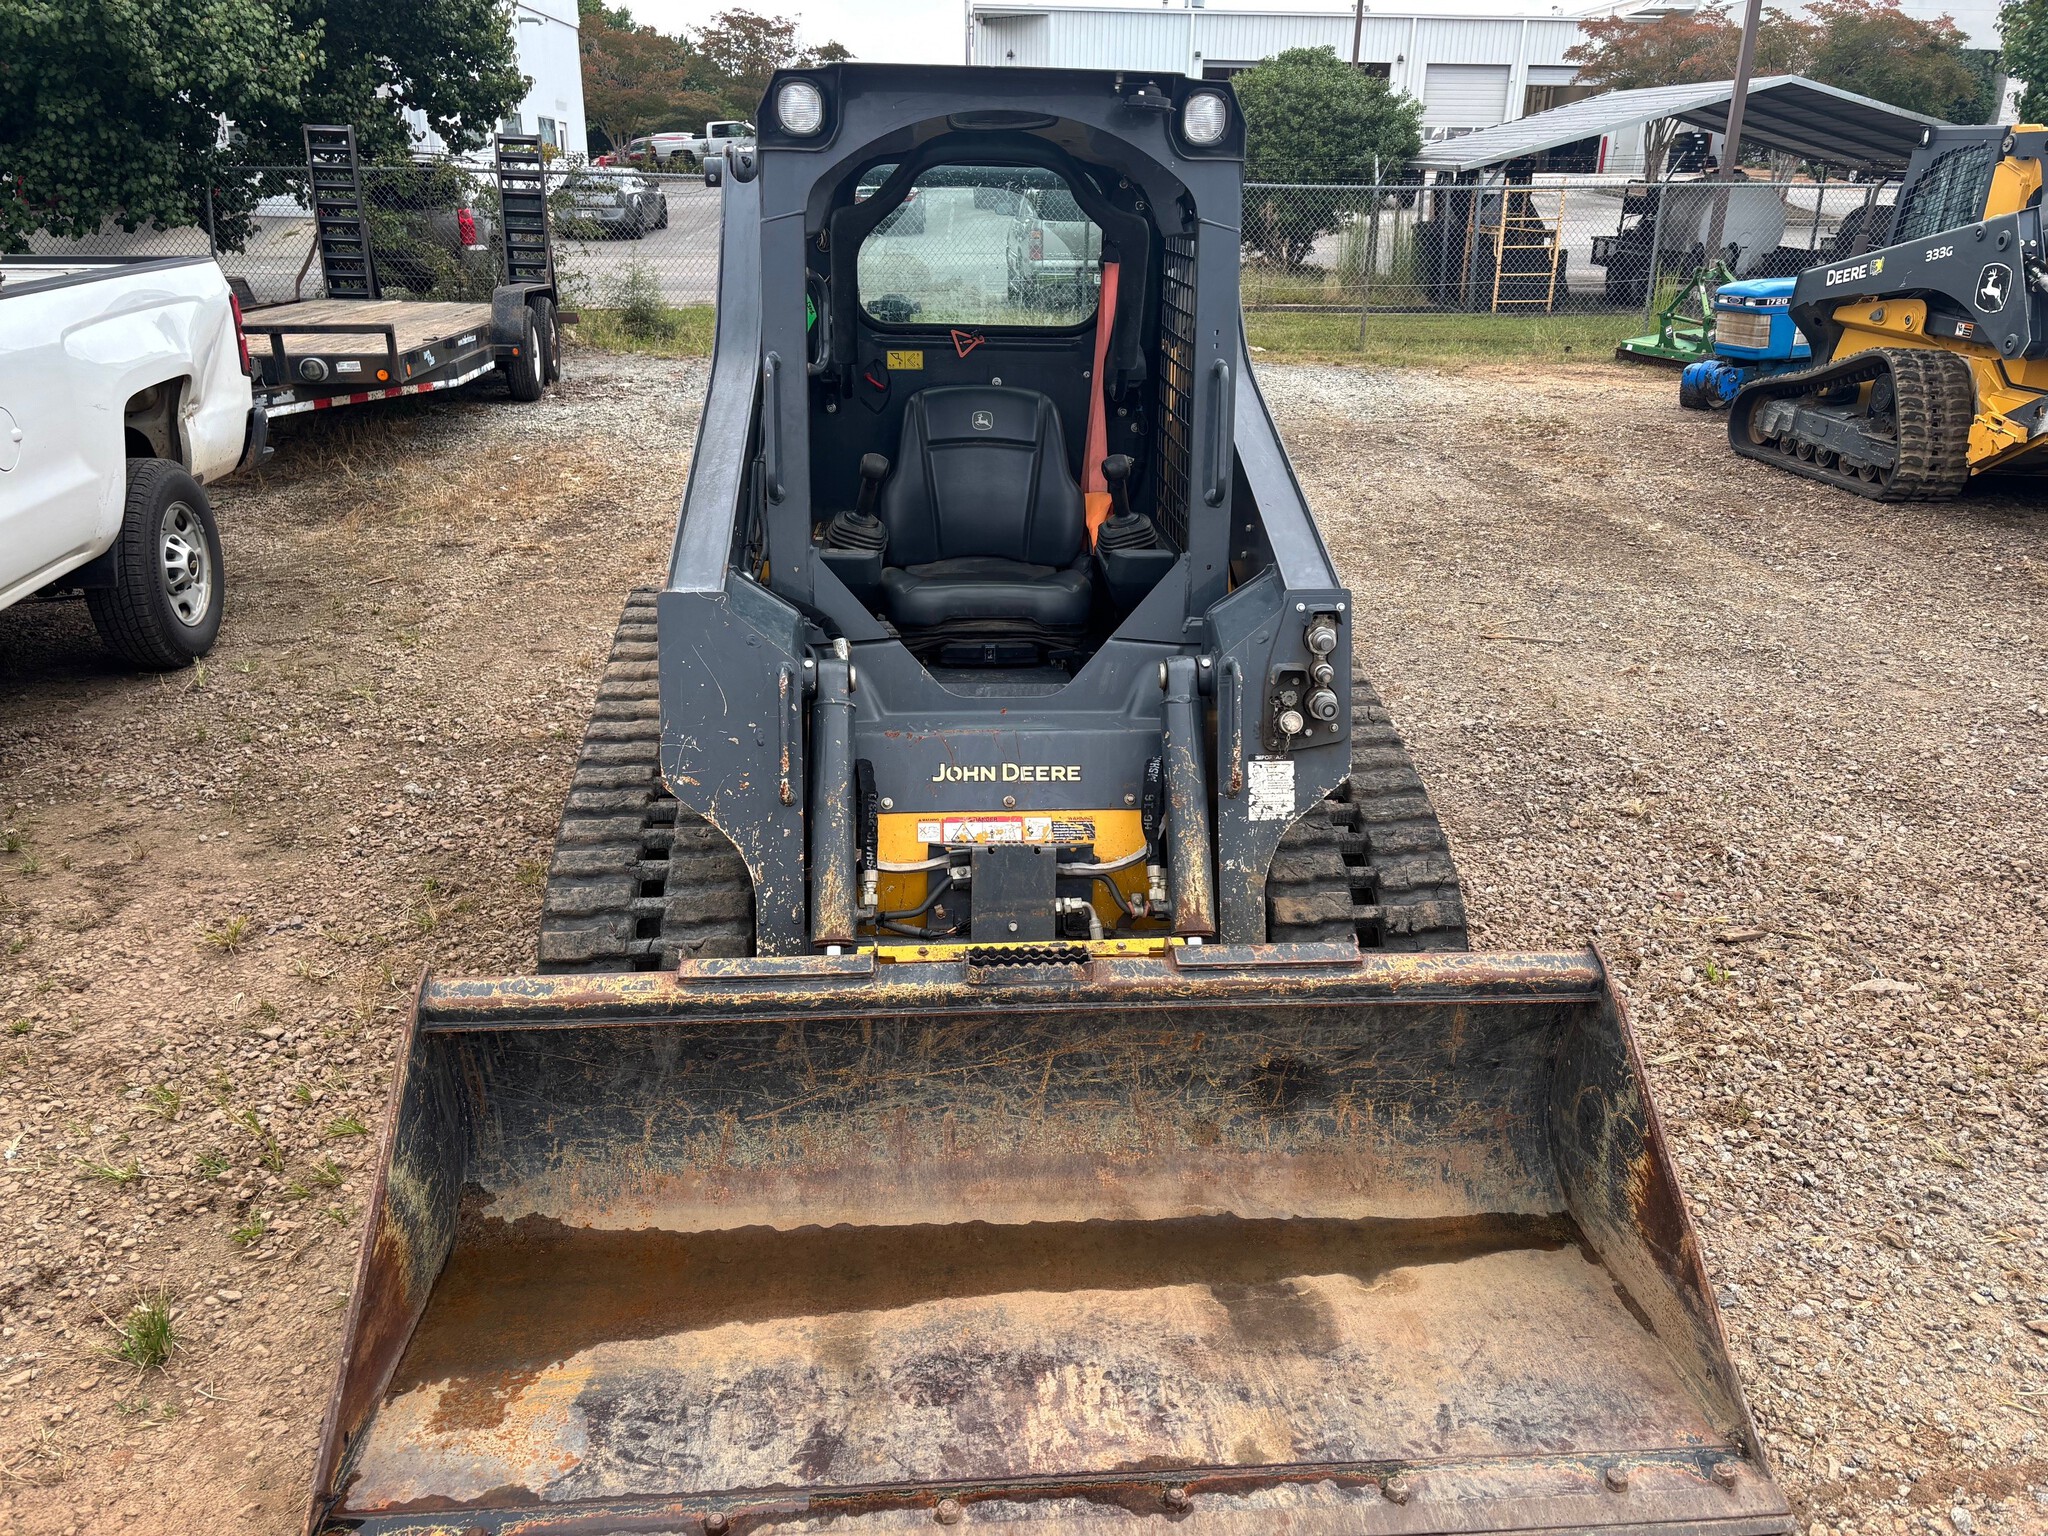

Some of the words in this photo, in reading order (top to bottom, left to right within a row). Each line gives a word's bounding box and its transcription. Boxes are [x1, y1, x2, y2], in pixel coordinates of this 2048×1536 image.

[1925, 246, 1953, 262] 333G
[1826, 264, 1868, 286] DEERE
[932, 763, 996, 782] JOHN
[1002, 762, 1081, 781] DEERE
